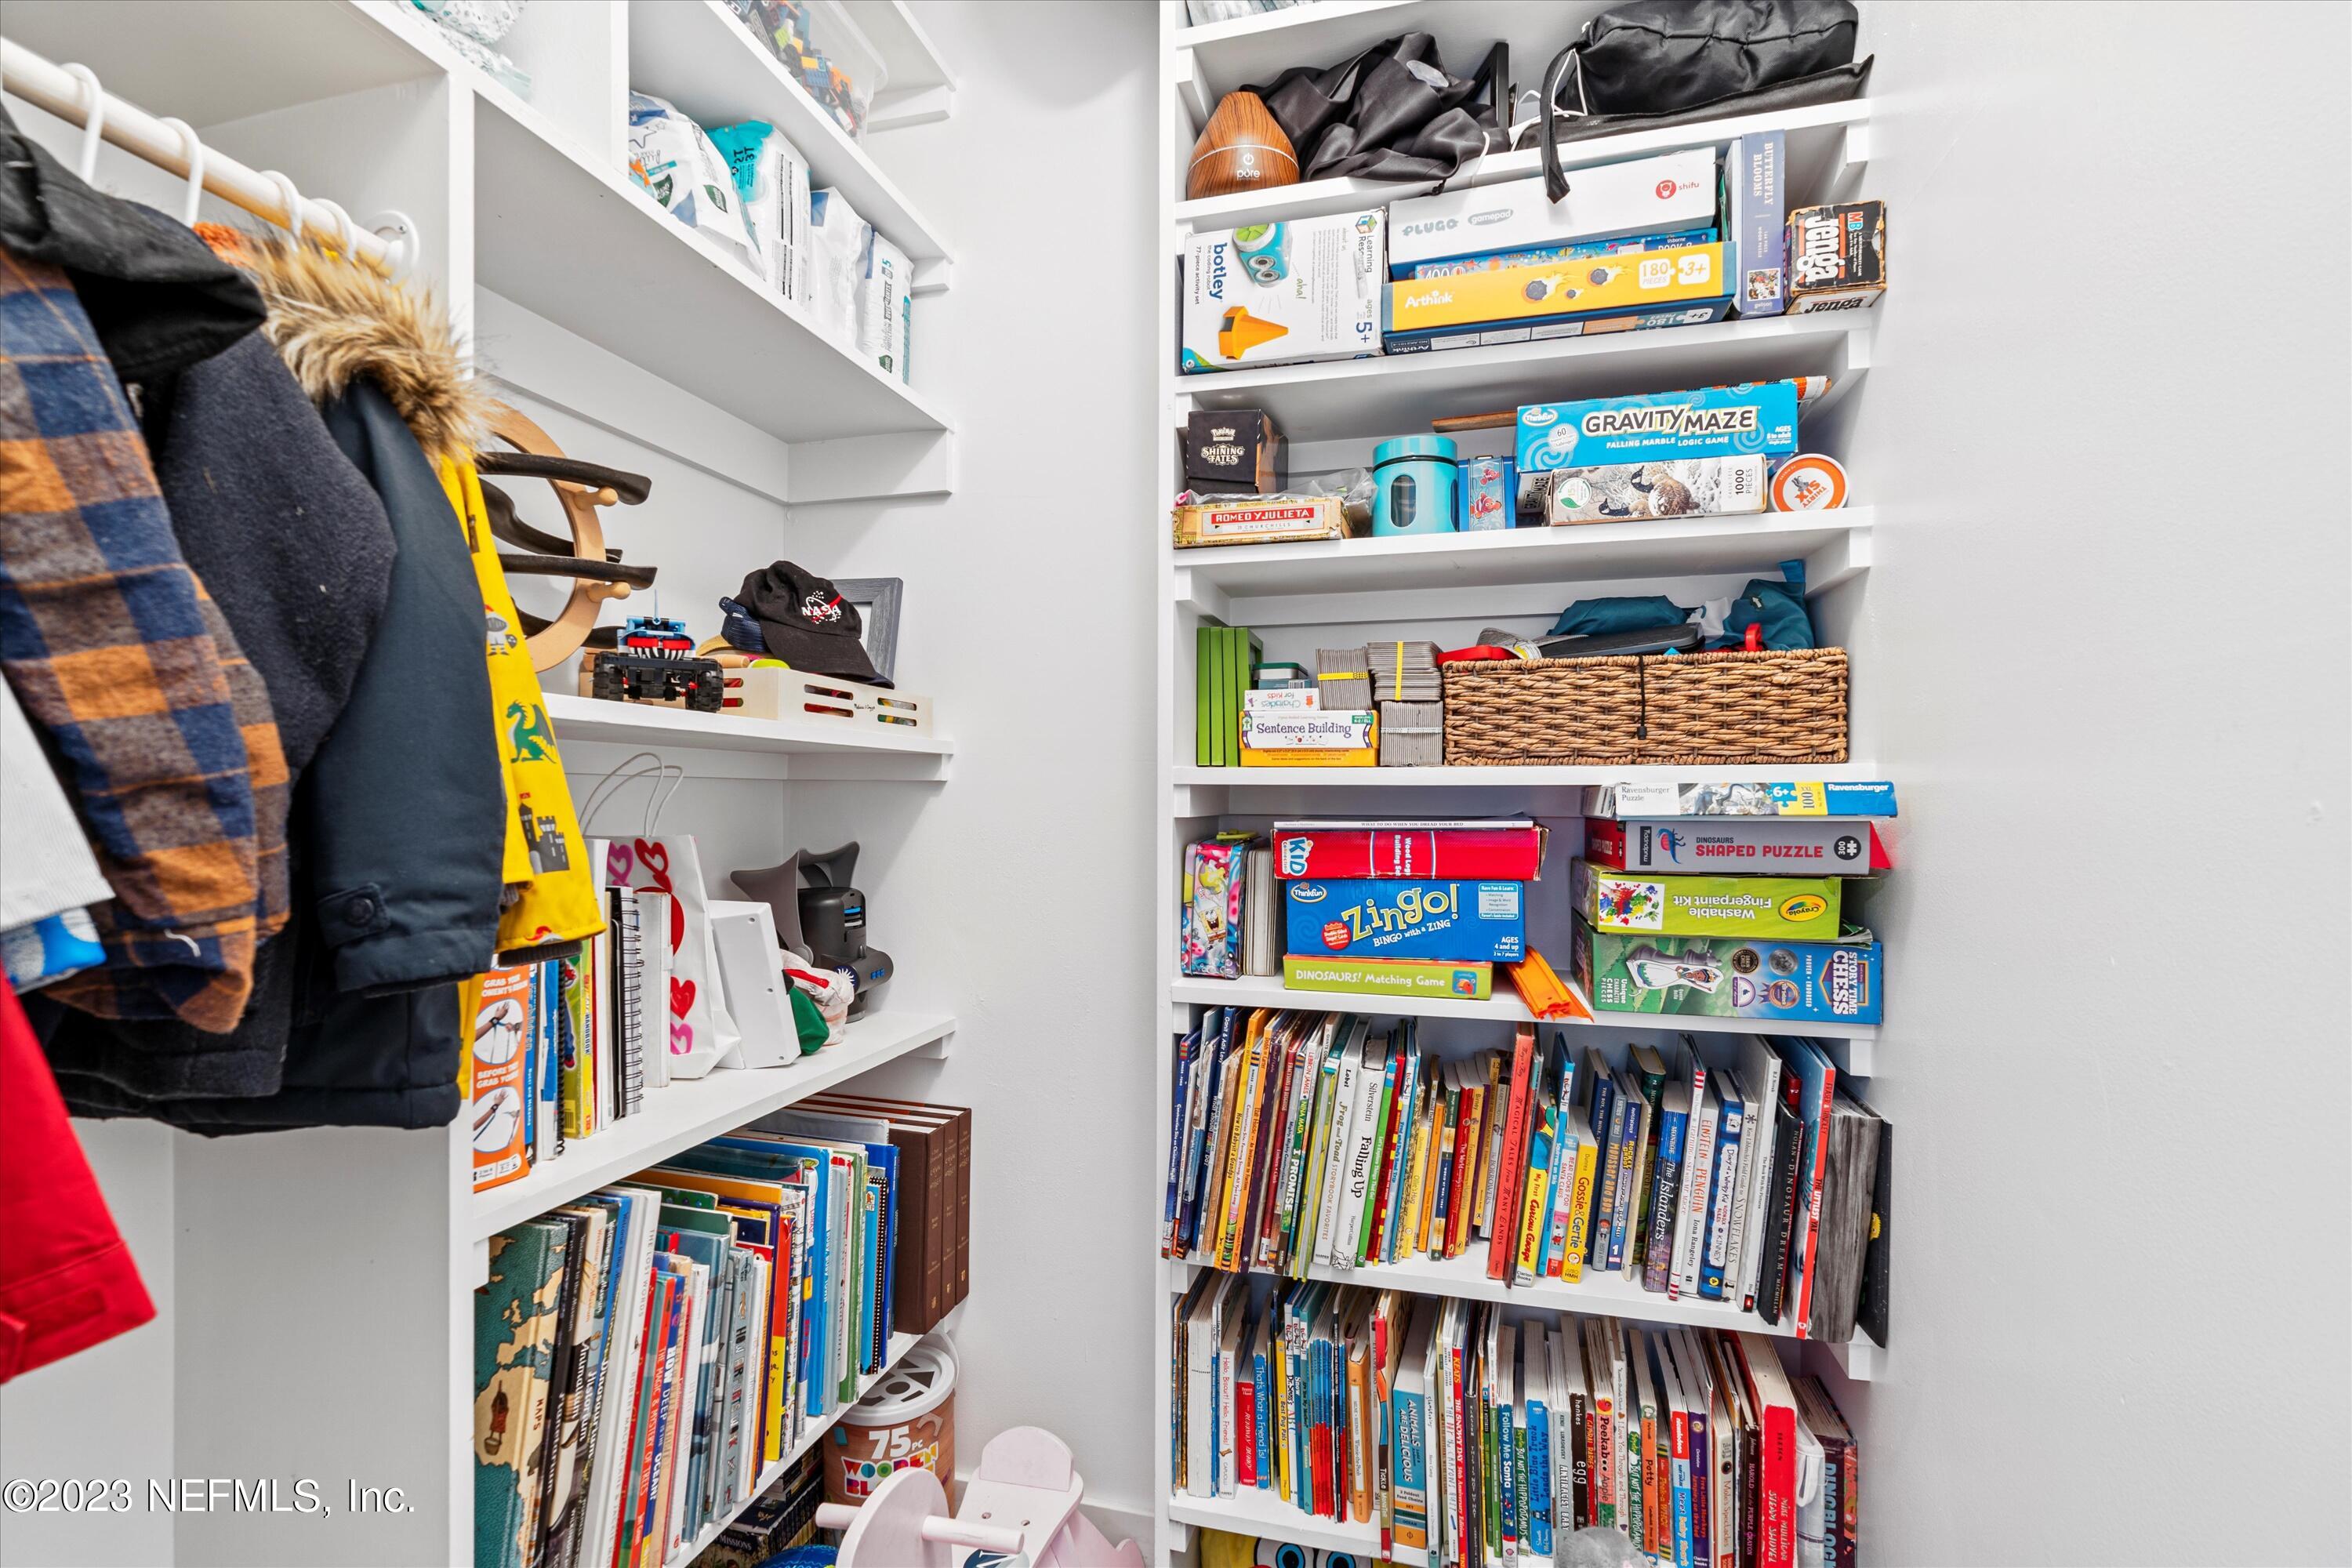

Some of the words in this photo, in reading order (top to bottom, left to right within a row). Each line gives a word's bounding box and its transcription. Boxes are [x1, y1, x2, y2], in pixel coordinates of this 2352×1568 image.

[1679, 181, 1700, 191] shifu
[1754, 154, 1762, 197] BLOOMS
[1764, 142, 1773, 205] BUTTERFLY
[1402, 219, 1459, 236] PLUGO
[1471, 209, 1512, 225] gamepad
[1365, 235, 1374, 273] Learning
[1796, 216, 1846, 283] Jenga
[1210, 242, 1228, 299] botley
[1642, 262, 1668, 276] 180
[1685, 262, 1706, 276] 3+
[1296, 278, 1307, 299] aha!
[1405, 290, 1453, 308] Arthink
[1356, 321, 1372, 343] 5+
[1557, 427, 1567, 437] 60
[1585, 408, 1686, 433] GRAVITY
[1684, 410, 1753, 432] MAZE
[1201, 445, 1245, 456] SHINING
[1642, 437, 1676, 447] MARBLE
[1735, 470, 1744, 495] 1000
[1795, 480, 1821, 503] SIX
[1216, 512, 1252, 522] ROMEO
[1261, 510, 1309, 520] JULIETA
[801, 604, 842, 616] NASA
[1257, 723, 1305, 734] Sentence
[1308, 723, 1352, 738] Building
[1621, 786, 1670, 795] Ravensburger
[1773, 786, 1789, 797] 6+
[1828, 783, 1889, 793] Ravensburger
[1290, 838, 1305, 874] KID
[1696, 845, 1755, 857] SHAPED
[1763, 845, 1824, 858] PUZZLE
[1341, 884, 1458, 942] Zingo!
[1673, 895, 1695, 906] Kit
[1700, 896, 1772, 909] Fingerpaint
[1788, 904, 1820, 916] Crayola
[1689, 908, 1755, 919] Washable
[1373, 934, 1403, 947] BINGO
[1404, 928, 1421, 938] with
[1427, 920, 1450, 933] ZING
[1296, 970, 1361, 982] DINOSAURS!
[1365, 973, 1413, 987] Matching
[1416, 975, 1445, 986] Game
[1832, 950, 1849, 1015] CHESS
[1303, 1076, 1312, 1094] JAMES
[1343, 1069, 1352, 1087] Lobel
[1338, 1102, 1348, 1127] Frog
[1365, 1083, 1378, 1122] Silverstein
[1297, 1116, 1305, 1134] MATA
[1333, 1139, 1343, 1163] Toad
[1669, 1125, 1678, 1155] MONROE
[1699, 1119, 1712, 1159] EINSTEIN
[1790, 1131, 1799, 1156] NOLAN
[1351, 1136, 1372, 1175] Falling
[1536, 1173, 1541, 1182] My
[1666, 1161, 1675, 1178] The
[1284, 1158, 1300, 1211] PROMISE
[1328, 1164, 1338, 1203] STORYBOOK
[1351, 1177, 1365, 1199] Up
[1575, 1177, 1590, 1210] Gossie
[1692, 1167, 1708, 1213] PENGUIN
[1782, 1164, 1795, 1224] DINOSAUR
[1322, 1203, 1332, 1240] FAVORITES
[1526, 1199, 1540, 1232] Curious
[1655, 1178, 1675, 1241] Islanders
[1570, 1217, 1584, 1249] Gertie
[1728, 1197, 1745, 1264] SNOWFLAKES
[1687, 1234, 1698, 1267] Rangeley
[1712, 1234, 1724, 1262] KINNEY
[1777, 1231, 1787, 1271] DREAM
[658, 1345, 666, 1361] THE
[663, 1345, 677, 1384] HOW
[652, 1367, 663, 1394] MAGIC
[1254, 1367, 1265, 1390] That's
[1453, 1356, 1461, 1384] KEATS
[533, 1398, 545, 1432] MAPS
[659, 1388, 671, 1421] DEEP
[1256, 1391, 1265, 1414] What
[645, 1407, 659, 1447] MYSTERY
[1257, 1421, 1266, 1447] Friend
[1406, 1399, 1420, 1447] ANIMALS
[869, 1425, 912, 1459] 75
[912, 1439, 924, 1451] PC
[1400, 1425, 1413, 1483] DELICIOUS
[1502, 1445, 1510, 1458] Me
[643, 1452, 652, 1464] OF
[640, 1468, 651, 1497] TREES
[1573, 1461, 1587, 1485] egg
[1645, 1460, 1653, 1486] Potty
[1559, 1465, 1569, 1510] ANTIRACIST
[1517, 1484, 1528, 1539] HIPPOPOTAMUS
[1560, 1512, 1569, 1530] BABY
